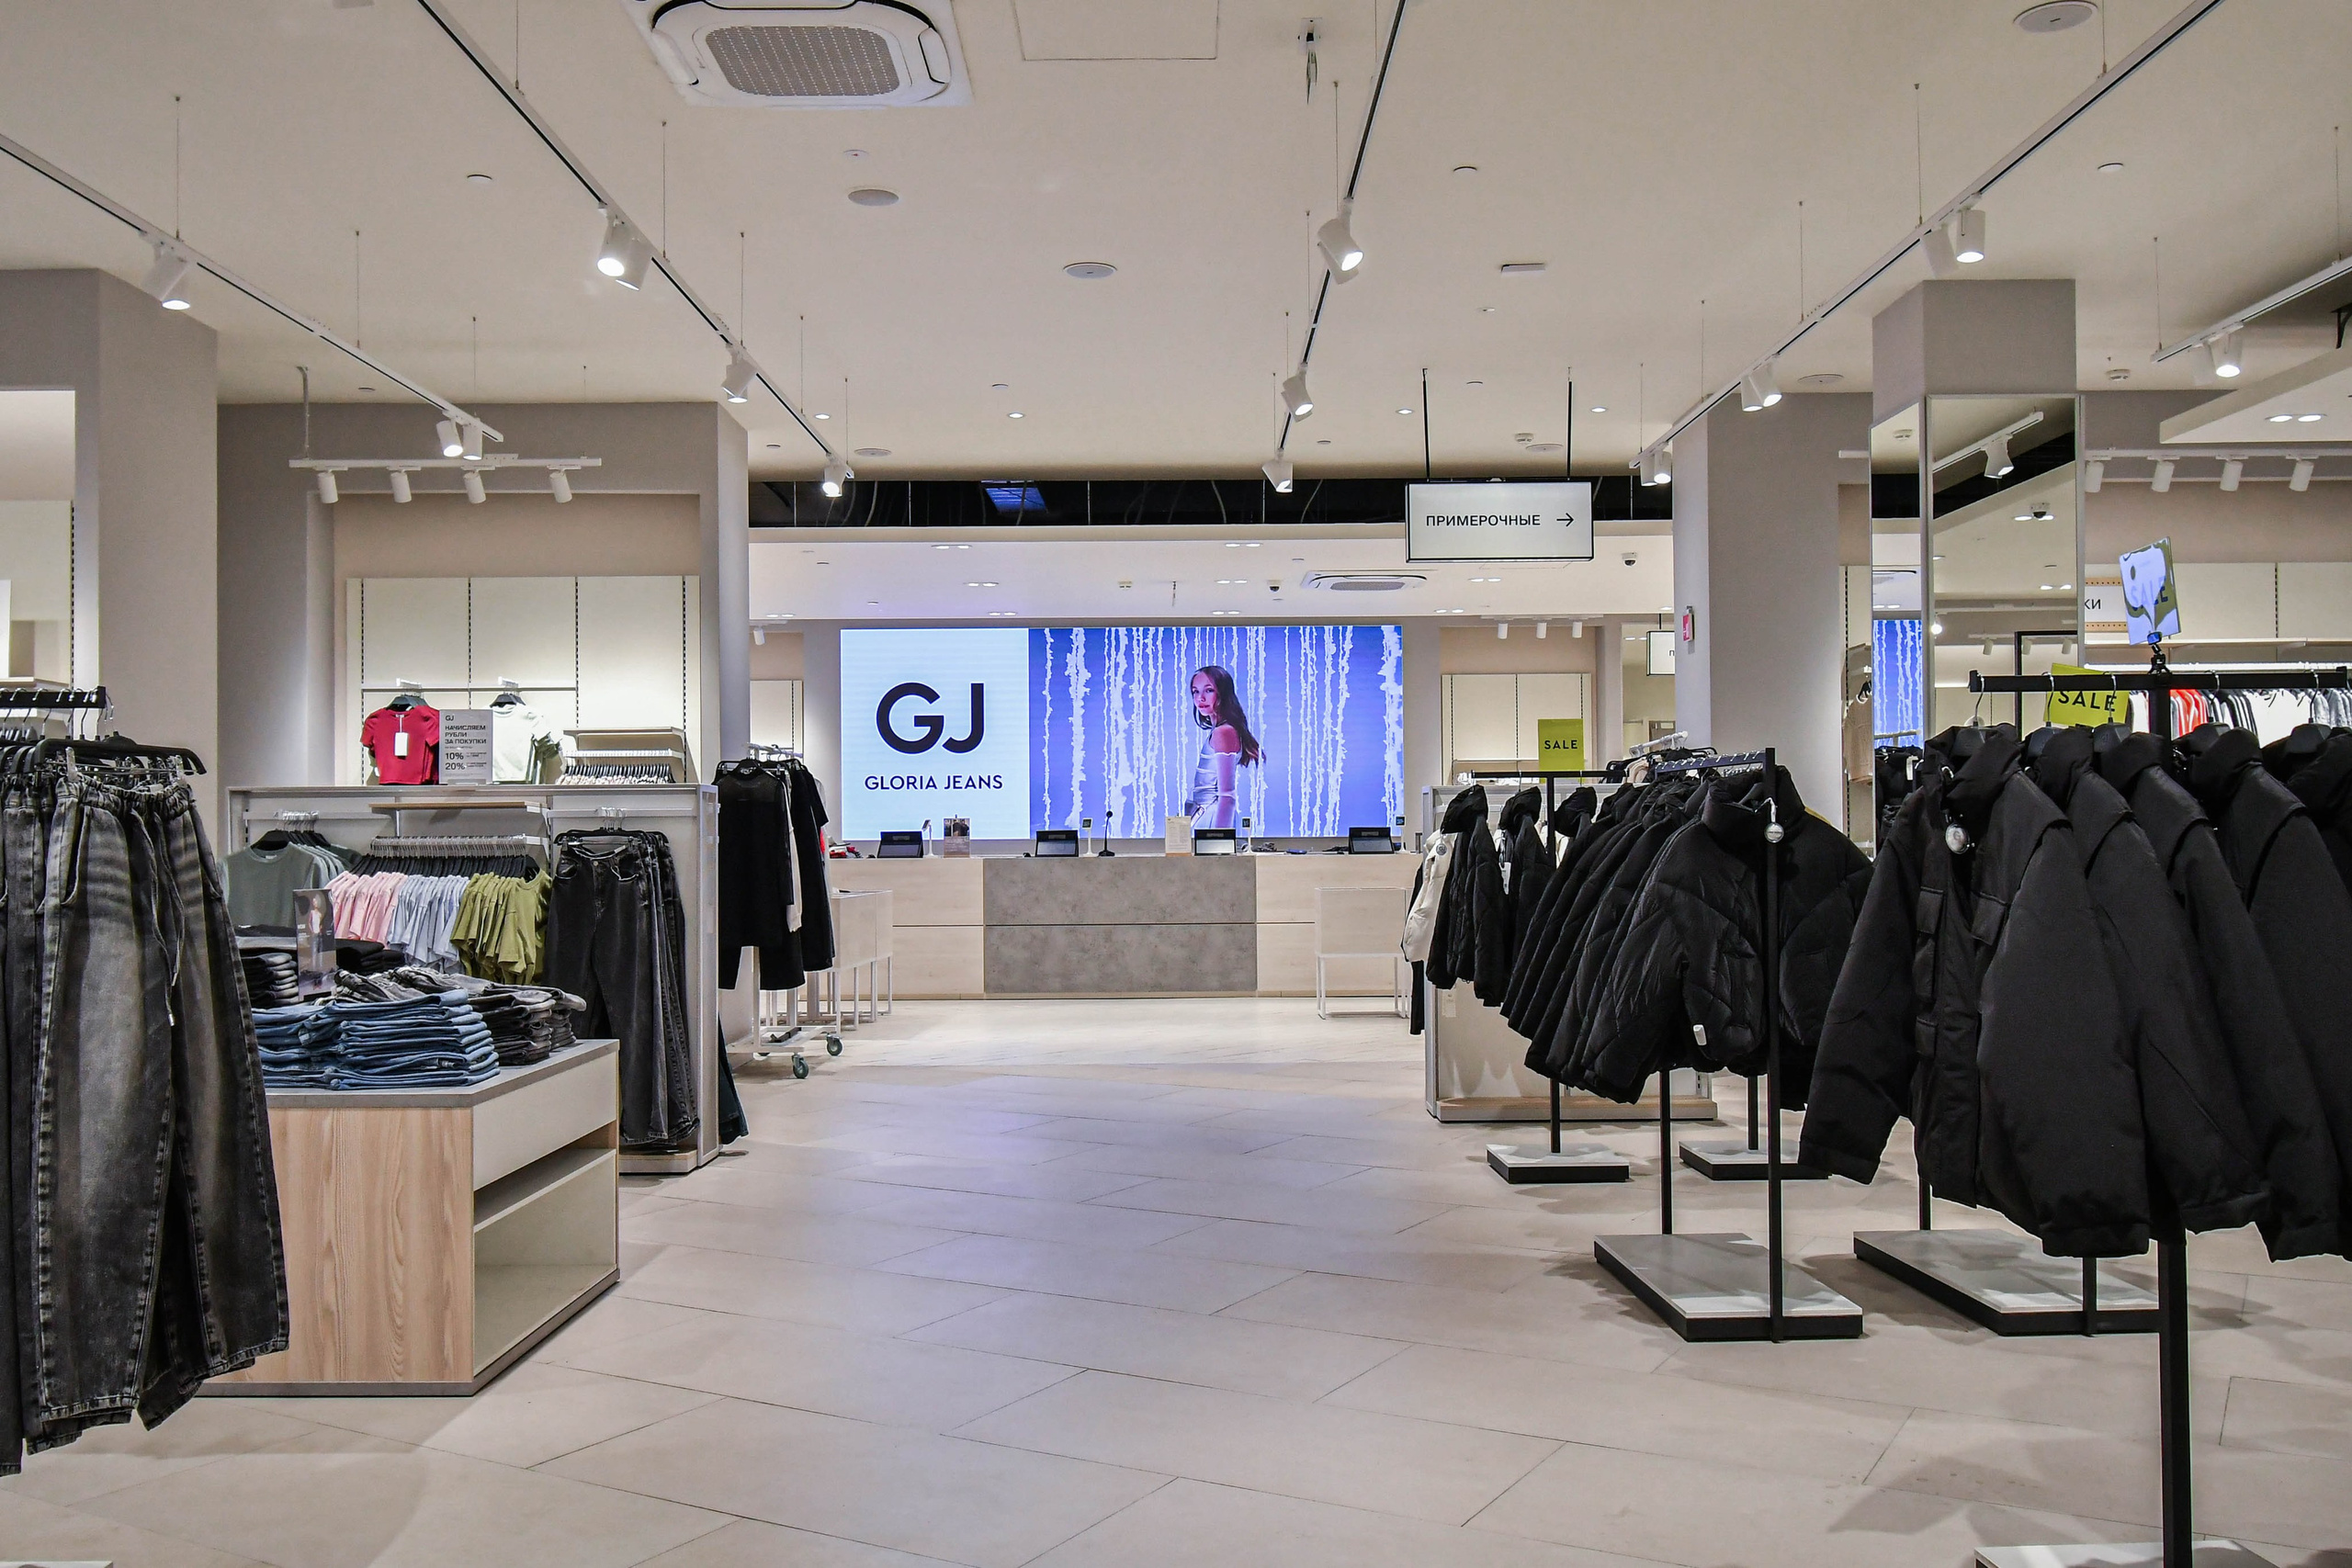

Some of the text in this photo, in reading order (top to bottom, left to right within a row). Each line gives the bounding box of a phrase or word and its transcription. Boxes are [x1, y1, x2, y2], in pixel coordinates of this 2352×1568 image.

[1426, 514, 1541, 526] ПРИМЕРОЧНЫЕ
[2058, 691, 2117, 712] SALE
[876, 682, 985, 755] GJ
[1544, 739, 1578, 750] SALE
[445, 762, 466, 771] 20%
[865, 774, 1003, 790] GLORIA JEANS
